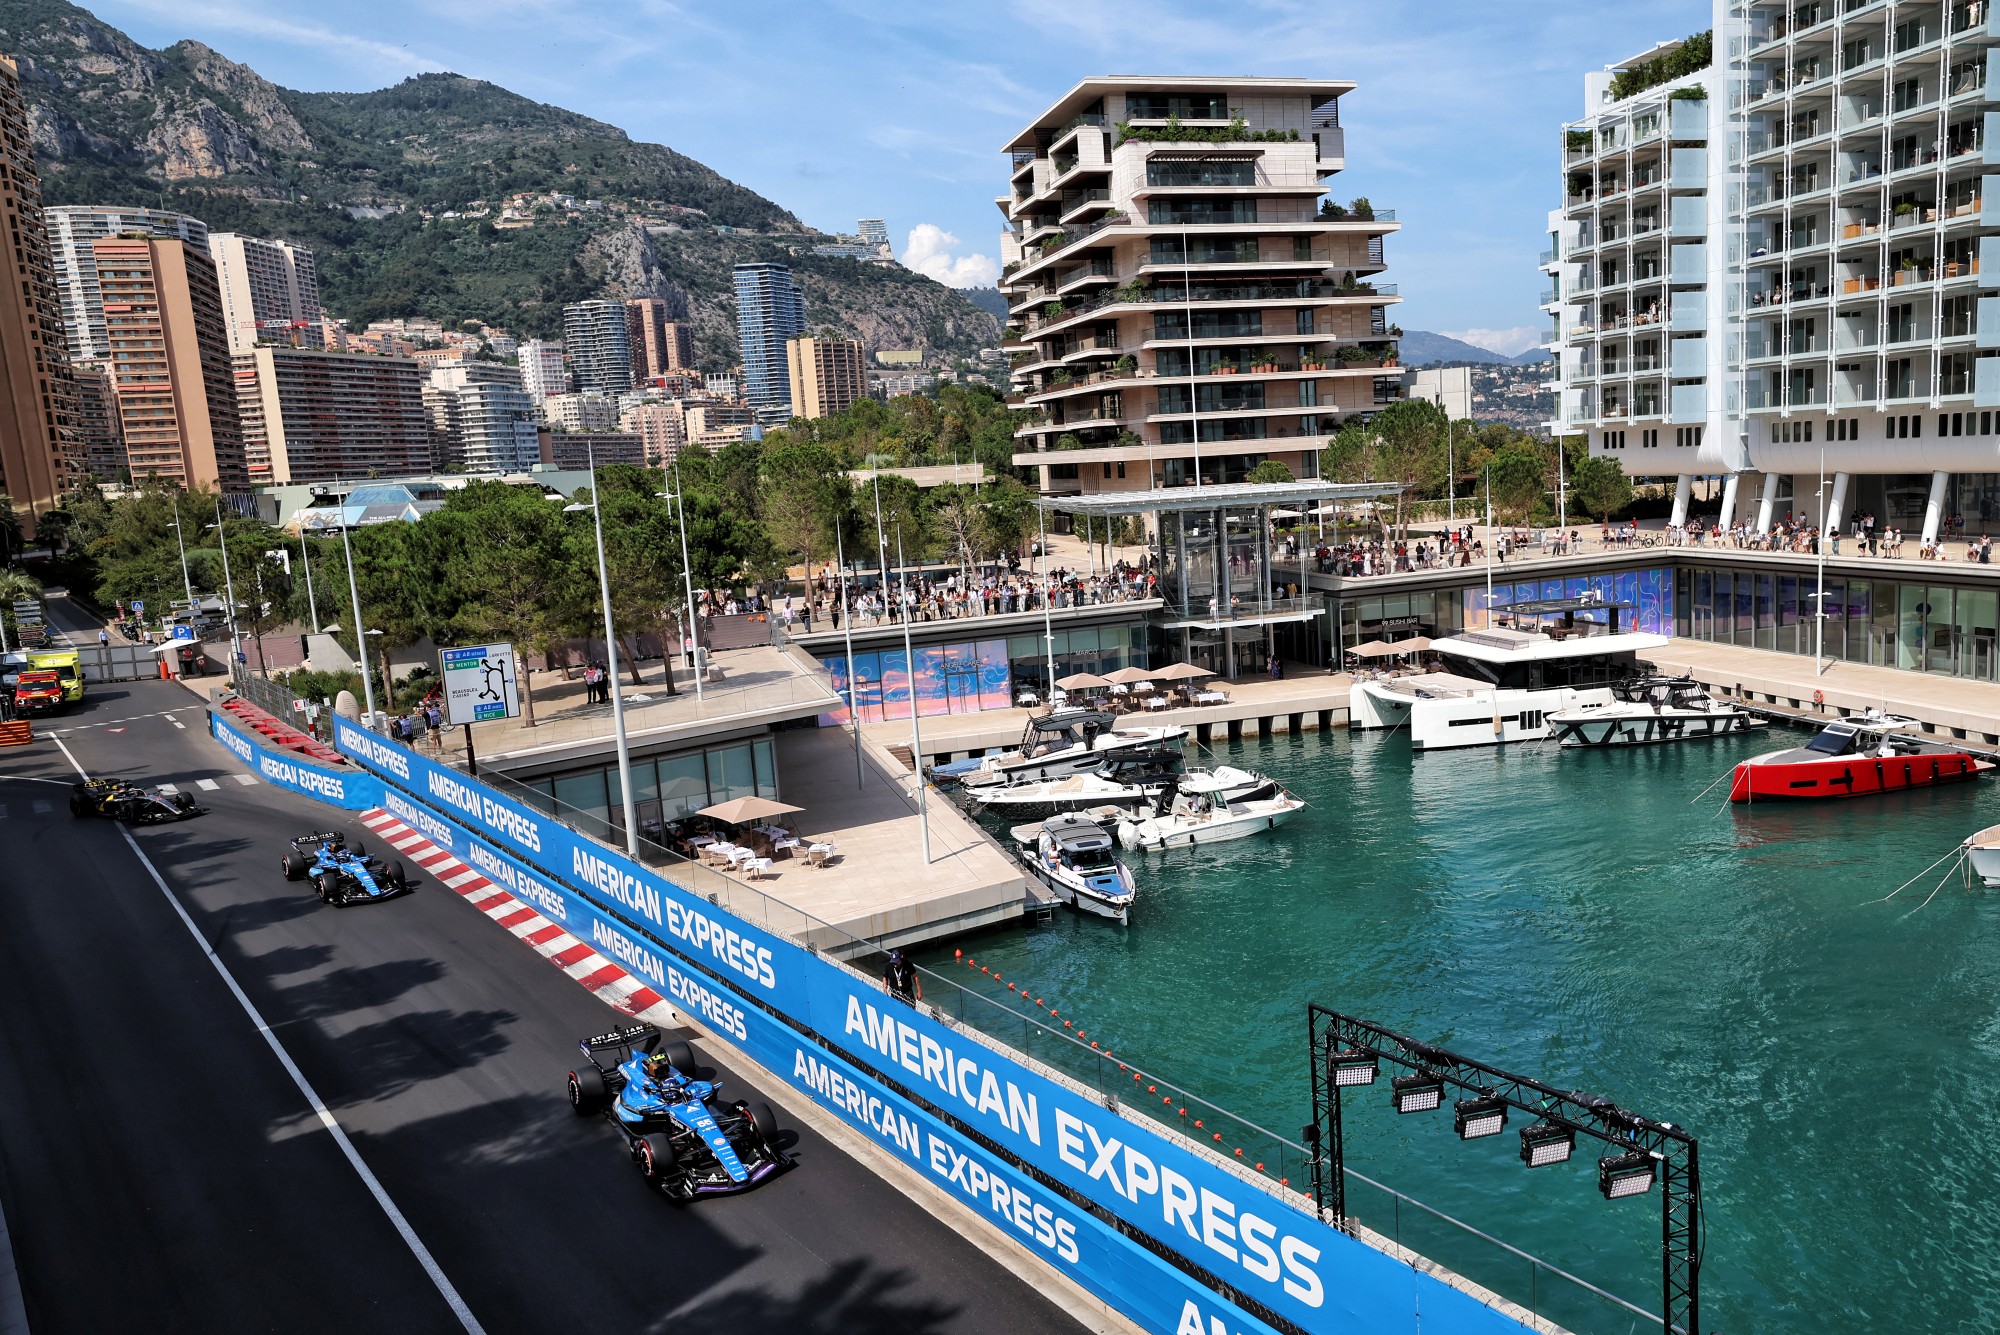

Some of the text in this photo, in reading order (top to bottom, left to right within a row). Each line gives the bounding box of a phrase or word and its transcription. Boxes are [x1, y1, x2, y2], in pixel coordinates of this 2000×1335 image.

[260, 755, 345, 800] AMERICAN EXPRESS
[340, 724, 410, 780] AMERICAN EXPRESS
[385, 790, 453, 847] AMERICAN EXPRESS
[428, 769, 541, 853] AMERICAN EXPRESS
[469, 842, 567, 920] AMERICAN EXPRESS
[573, 846, 776, 989] AMERICAN EXPRESS
[593, 918, 747, 1041] AMERICAN EXPRESS
[793, 1048, 1080, 1264] AMERICAN EXPRESS
[844, 994, 1325, 1308] AMERICAN EXPRESS
